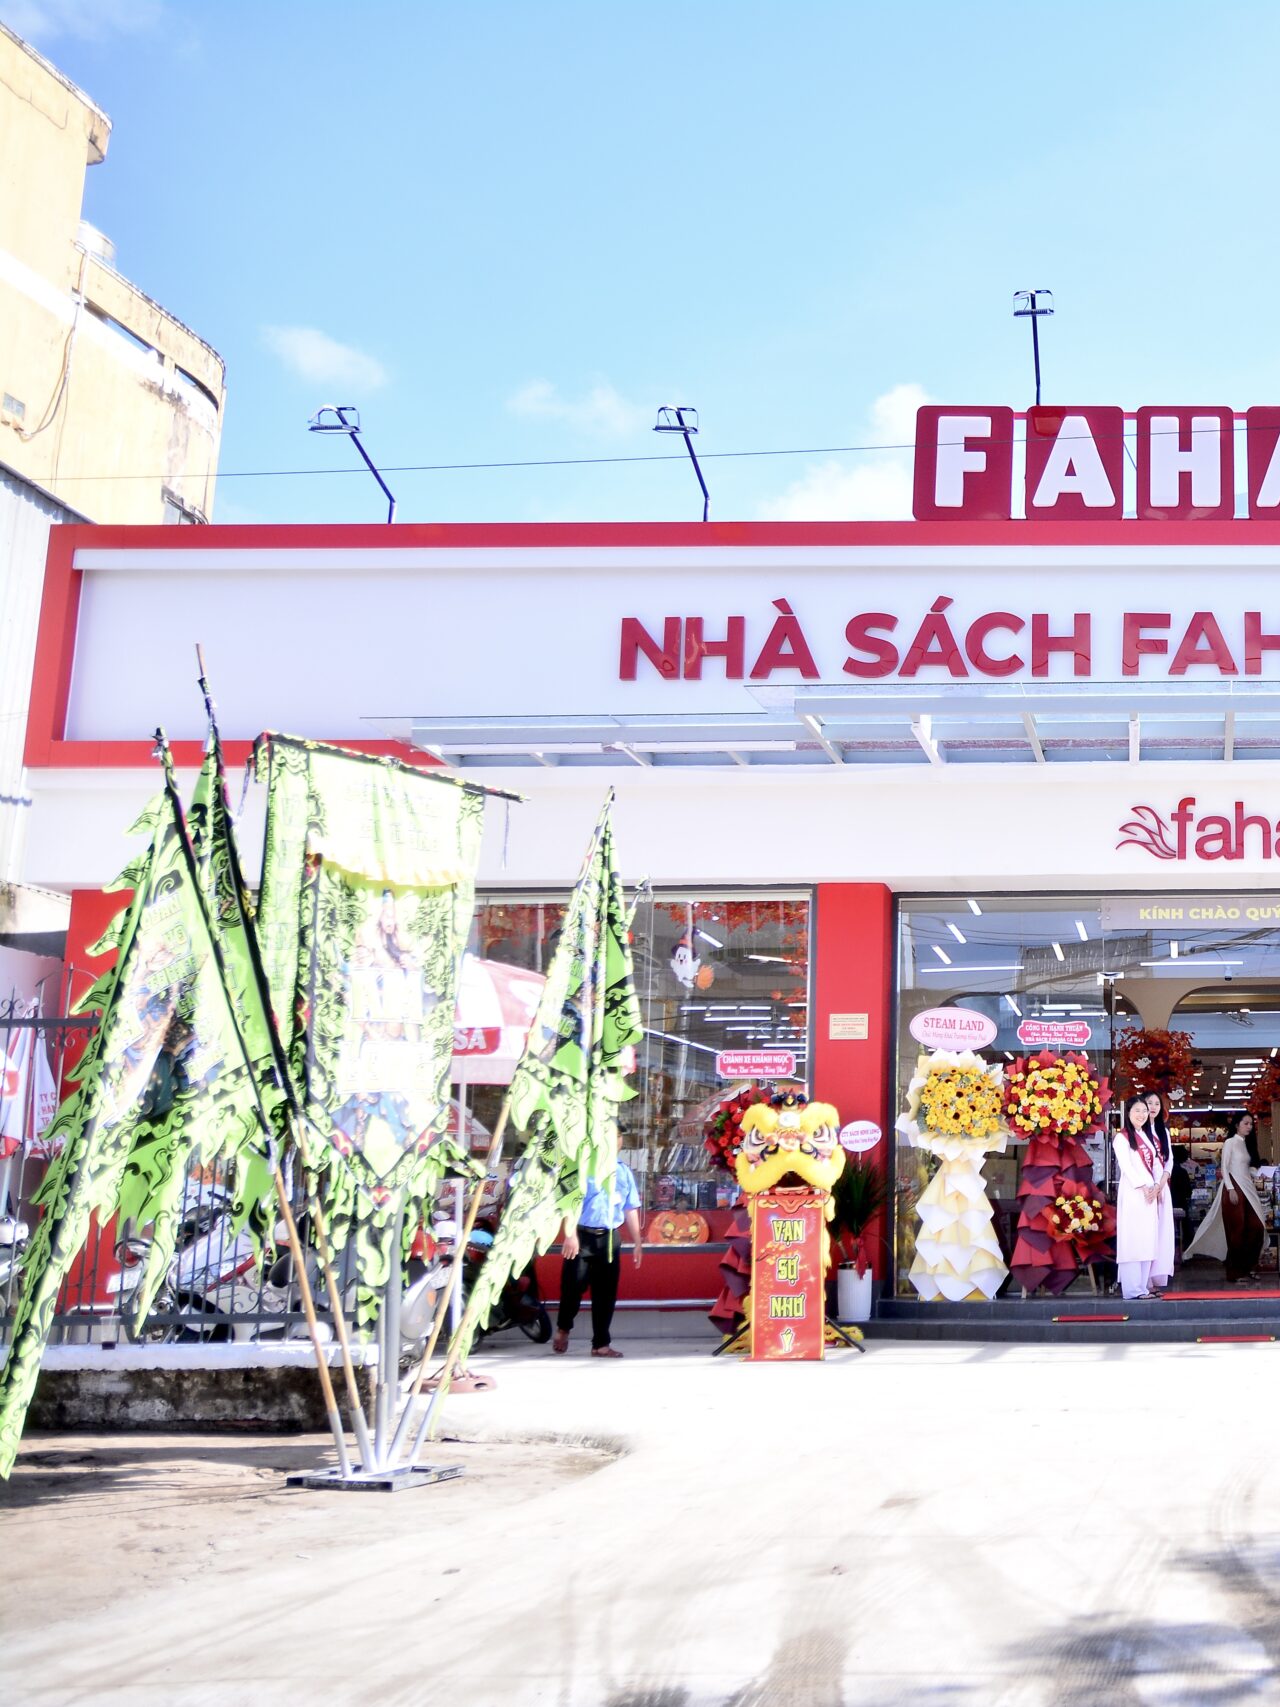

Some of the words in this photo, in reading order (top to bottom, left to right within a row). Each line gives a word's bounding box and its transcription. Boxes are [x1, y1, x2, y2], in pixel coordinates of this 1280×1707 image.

[619, 598, 821, 681] NHÀ
[842, 596, 1091, 679] SÁCH
[1139, 906, 1184, 919] KÍNH
[1189, 905, 1241, 919] CHÀO
[923, 1017, 956, 1029] STEAM
[959, 1019, 985, 1032] LAND
[771, 1219, 804, 1247] VẠN
[777, 1255, 800, 1285] SỰ
[770, 1293, 805, 1318] NHƯ
[780, 1328, 793, 1352] Ý
